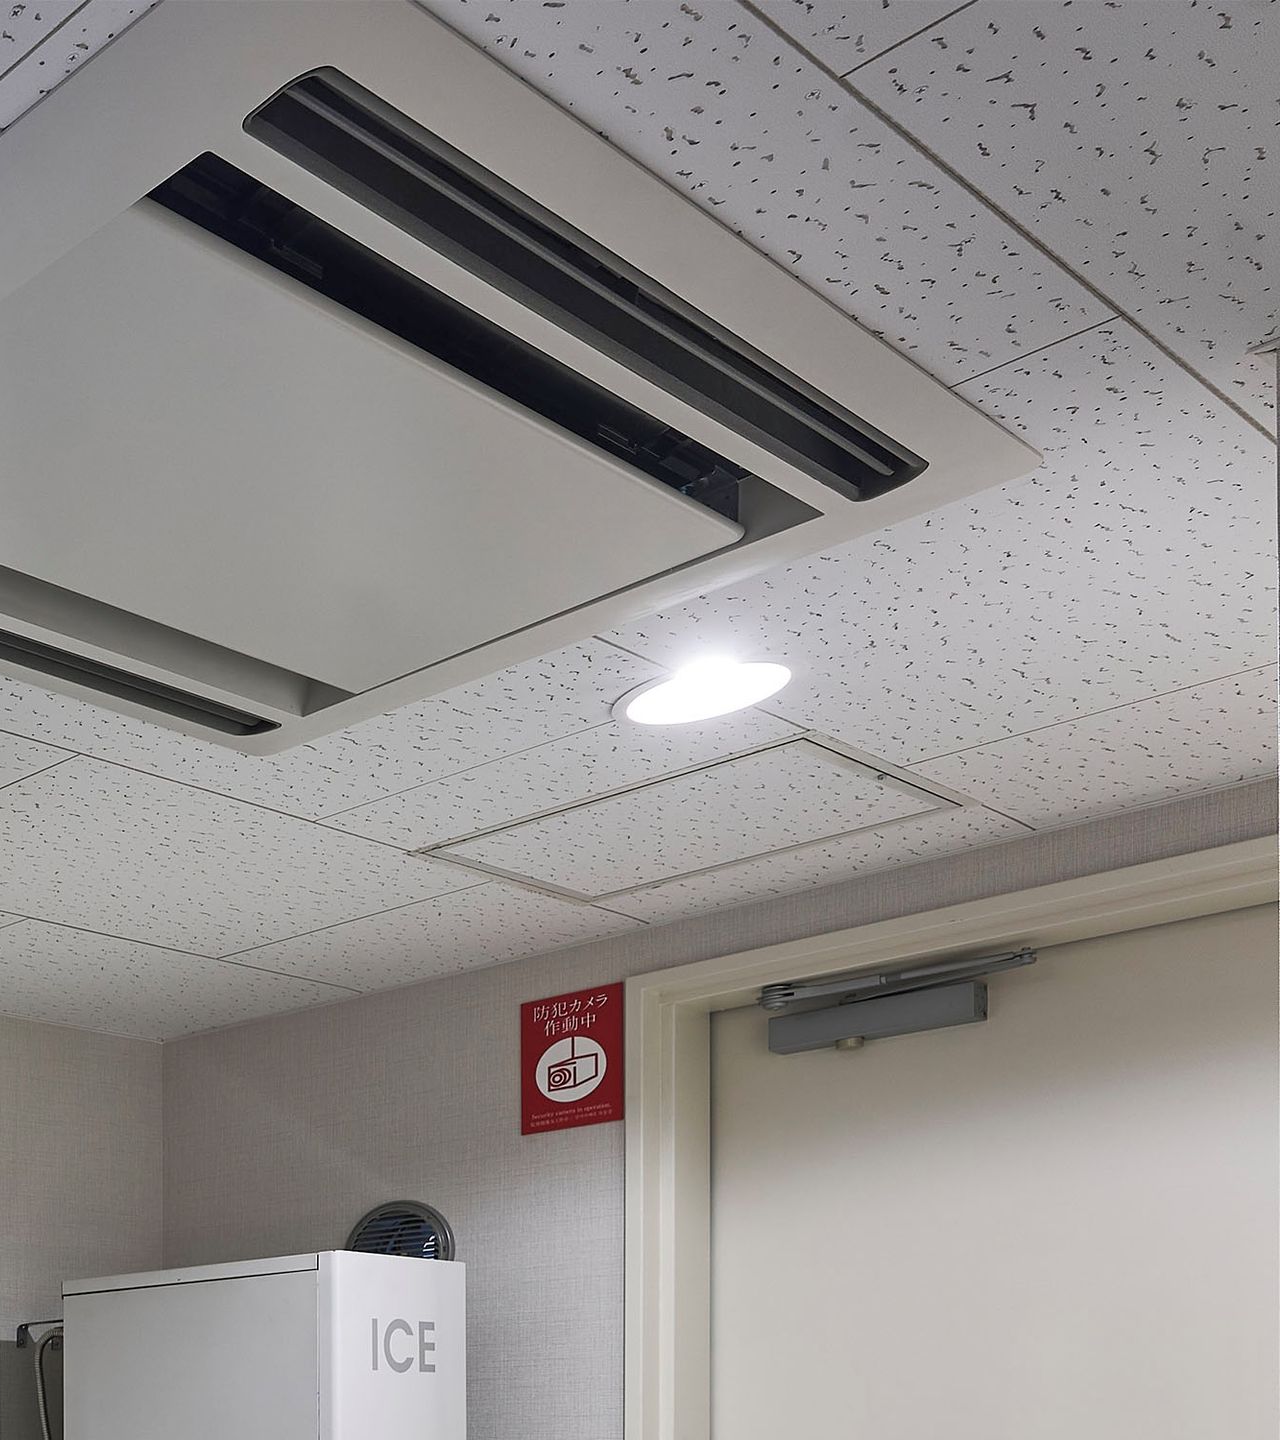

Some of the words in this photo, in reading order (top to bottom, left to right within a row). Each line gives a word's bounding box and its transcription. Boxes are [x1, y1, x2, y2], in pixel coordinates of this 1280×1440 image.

[533, 994, 608, 1022] 防犯カメラ
[544, 1012, 596, 1037] 作動中
[371, 1317, 436, 1373] ICE
